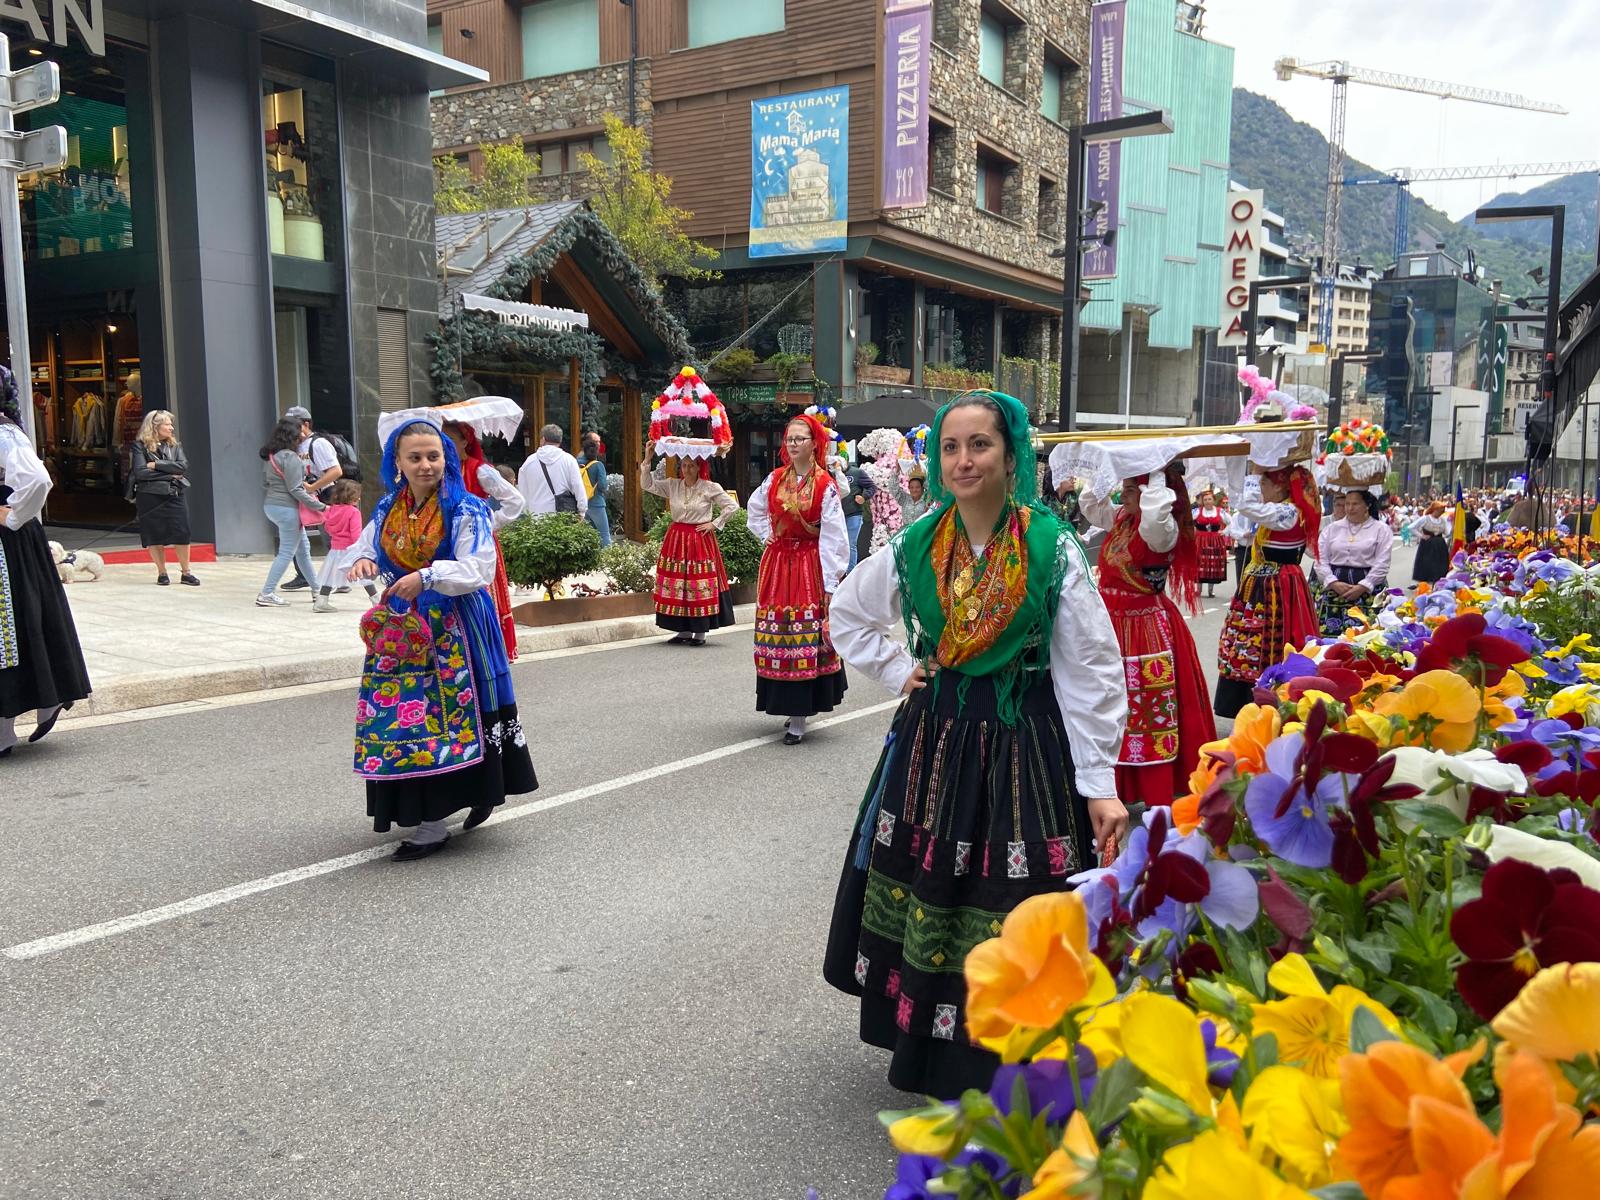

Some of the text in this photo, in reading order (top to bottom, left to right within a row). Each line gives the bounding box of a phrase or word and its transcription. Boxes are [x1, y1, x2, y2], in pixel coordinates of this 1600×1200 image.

[760, 93, 841, 113] RESTAURANT
[897, 24, 921, 147] PIZZERIA
[1100, 36, 1115, 113] RESTAURANT
[760, 127, 840, 153] Mama Maria
[1225, 199, 1254, 338] OMEGA
